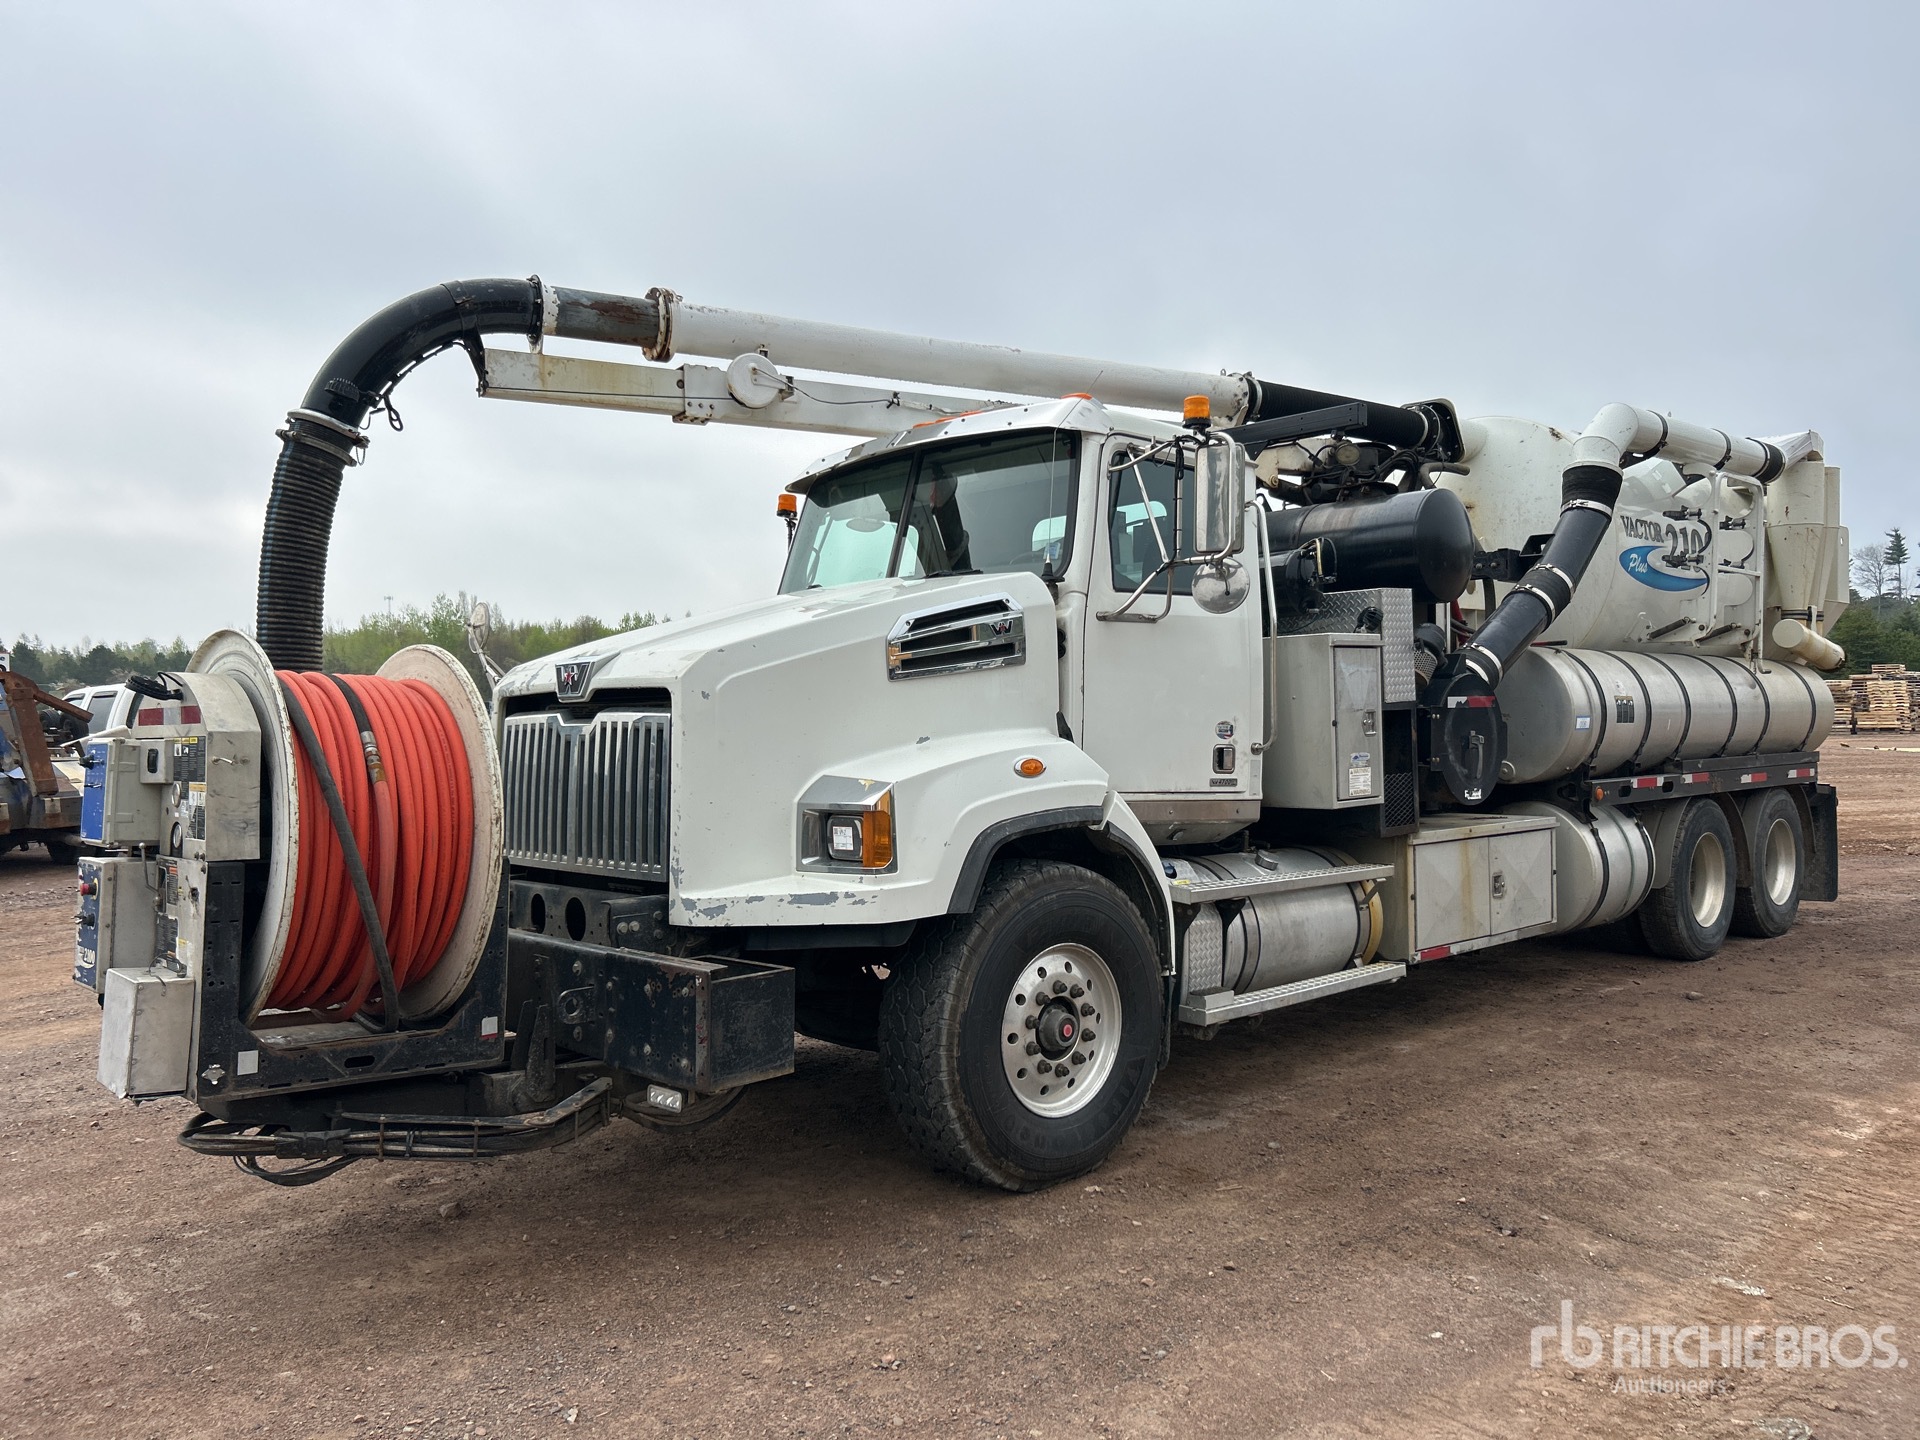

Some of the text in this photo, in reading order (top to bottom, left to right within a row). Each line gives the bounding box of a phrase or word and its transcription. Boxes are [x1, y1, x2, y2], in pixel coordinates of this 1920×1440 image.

[1620, 515, 1712, 572] VACTOR 210
[1628, 553, 1648, 573] Plus
